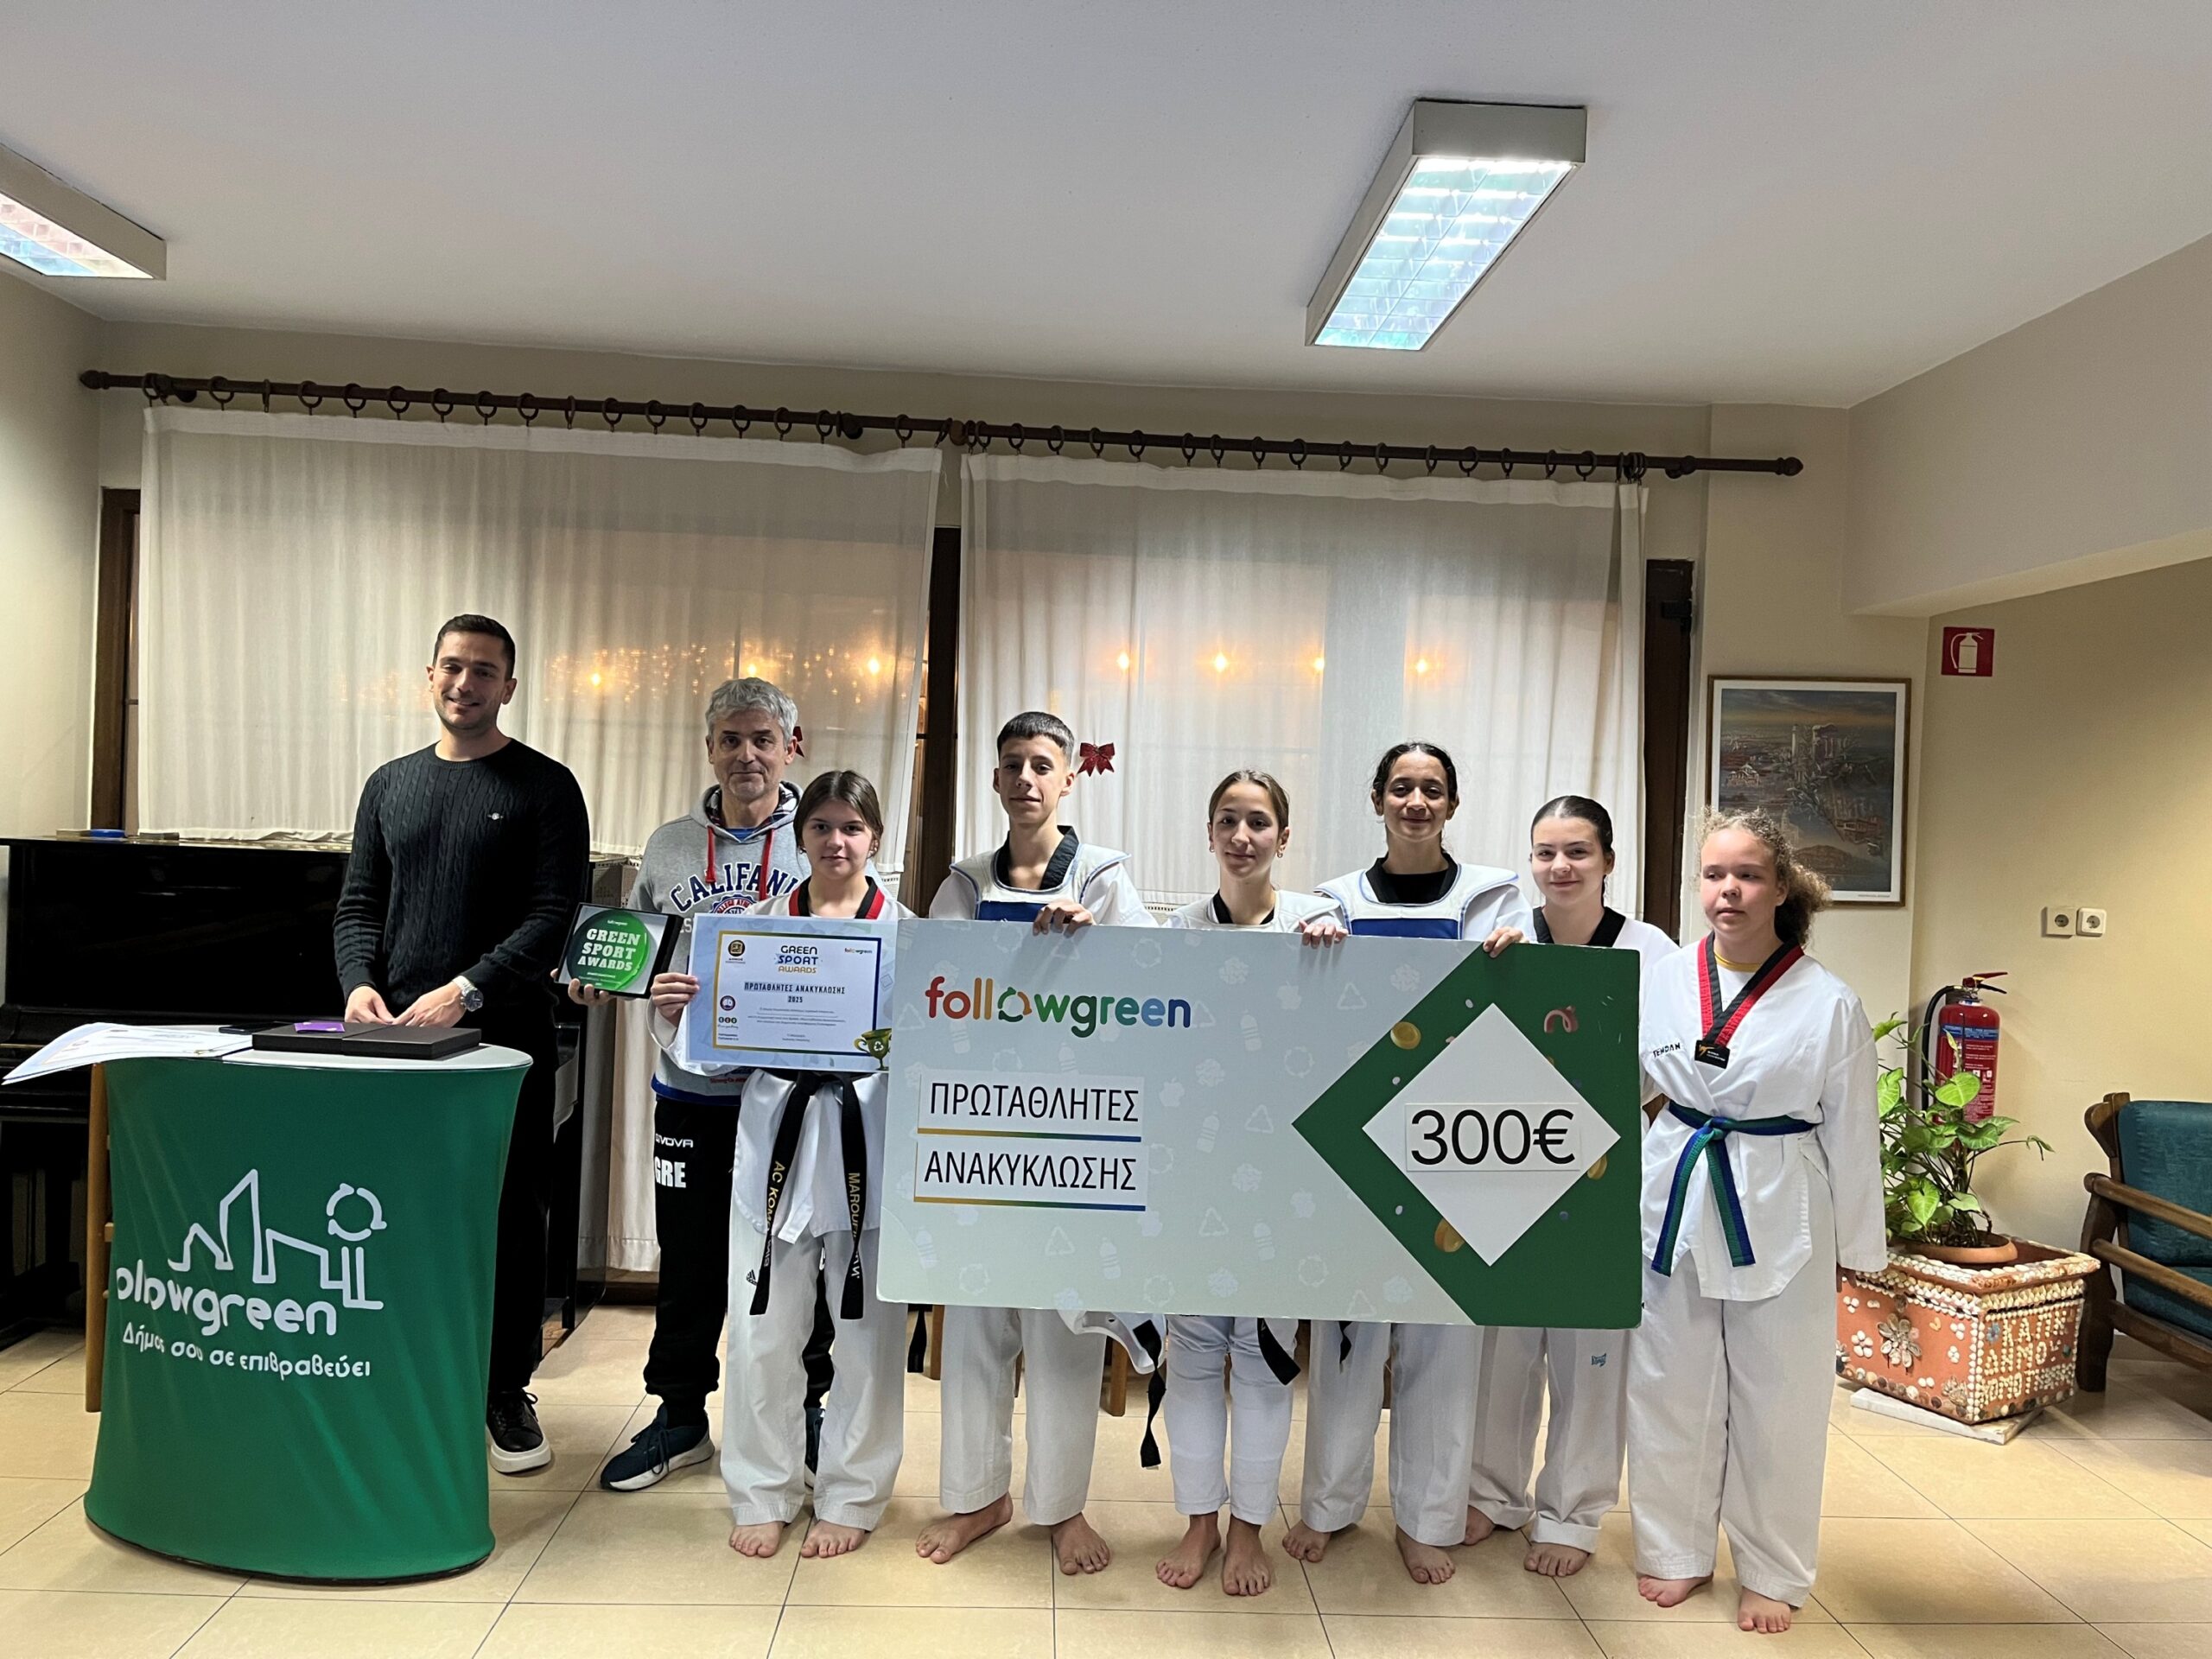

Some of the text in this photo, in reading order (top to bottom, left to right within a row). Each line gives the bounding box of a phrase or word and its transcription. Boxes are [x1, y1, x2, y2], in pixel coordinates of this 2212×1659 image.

[586, 928, 641, 946] GREEN
[582, 942, 637, 960] SPORT
[778, 955, 819, 965] SPORT
[780, 945, 817, 955] GREEN
[577, 956, 633, 971] AWARDS
[778, 965, 817, 974] AWARDS
[925, 976, 1192, 1038] followgreen
[930, 1083, 1139, 1122] ΠΡΩΤΑΘΛΗΤΕΣ
[1411, 1109, 1575, 1166] 300€
[654, 1155, 687, 1188] GRE
[772, 1160, 786, 1184] AC
[924, 1150, 1137, 1191] ΑΝΑΚΥΚΛΩΣΗΣ
[209, 1350, 235, 1367] σε
[239, 1351, 371, 1382] επιβραβεύει
